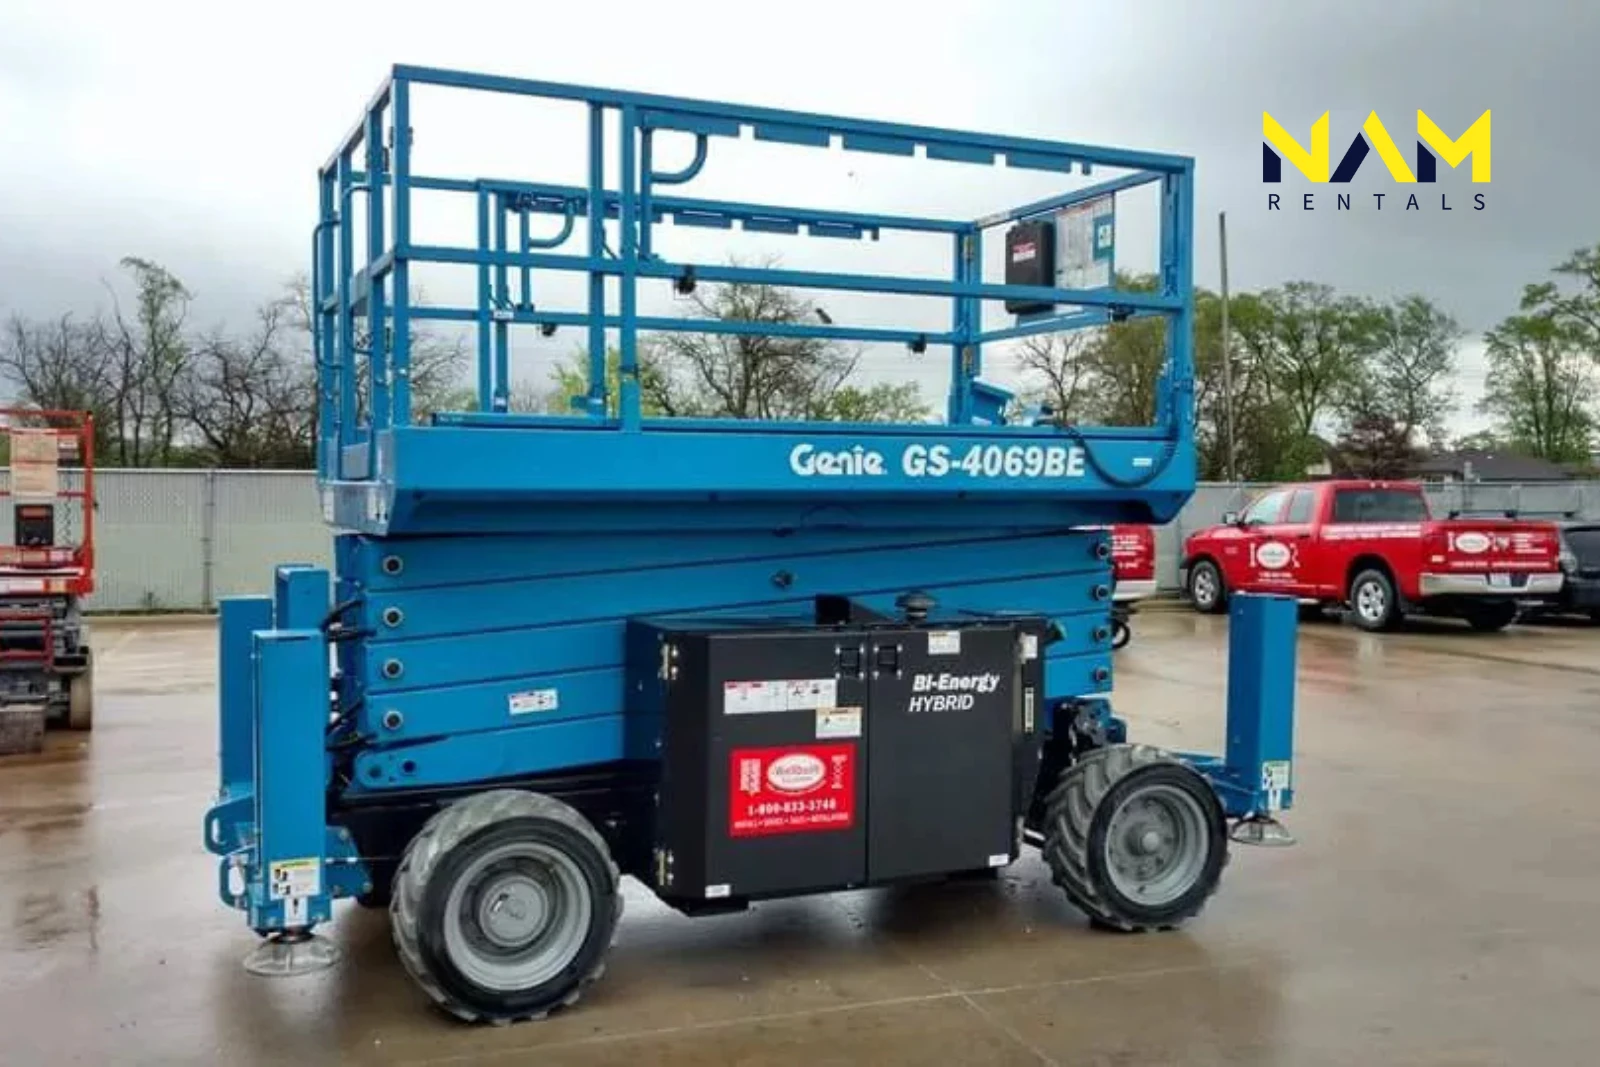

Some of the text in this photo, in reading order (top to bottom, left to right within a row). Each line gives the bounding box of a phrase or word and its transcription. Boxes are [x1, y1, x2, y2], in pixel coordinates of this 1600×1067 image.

[789, 443, 1085, 477] Genie GS-4069BE
[908, 694, 974, 712] HYBRID
